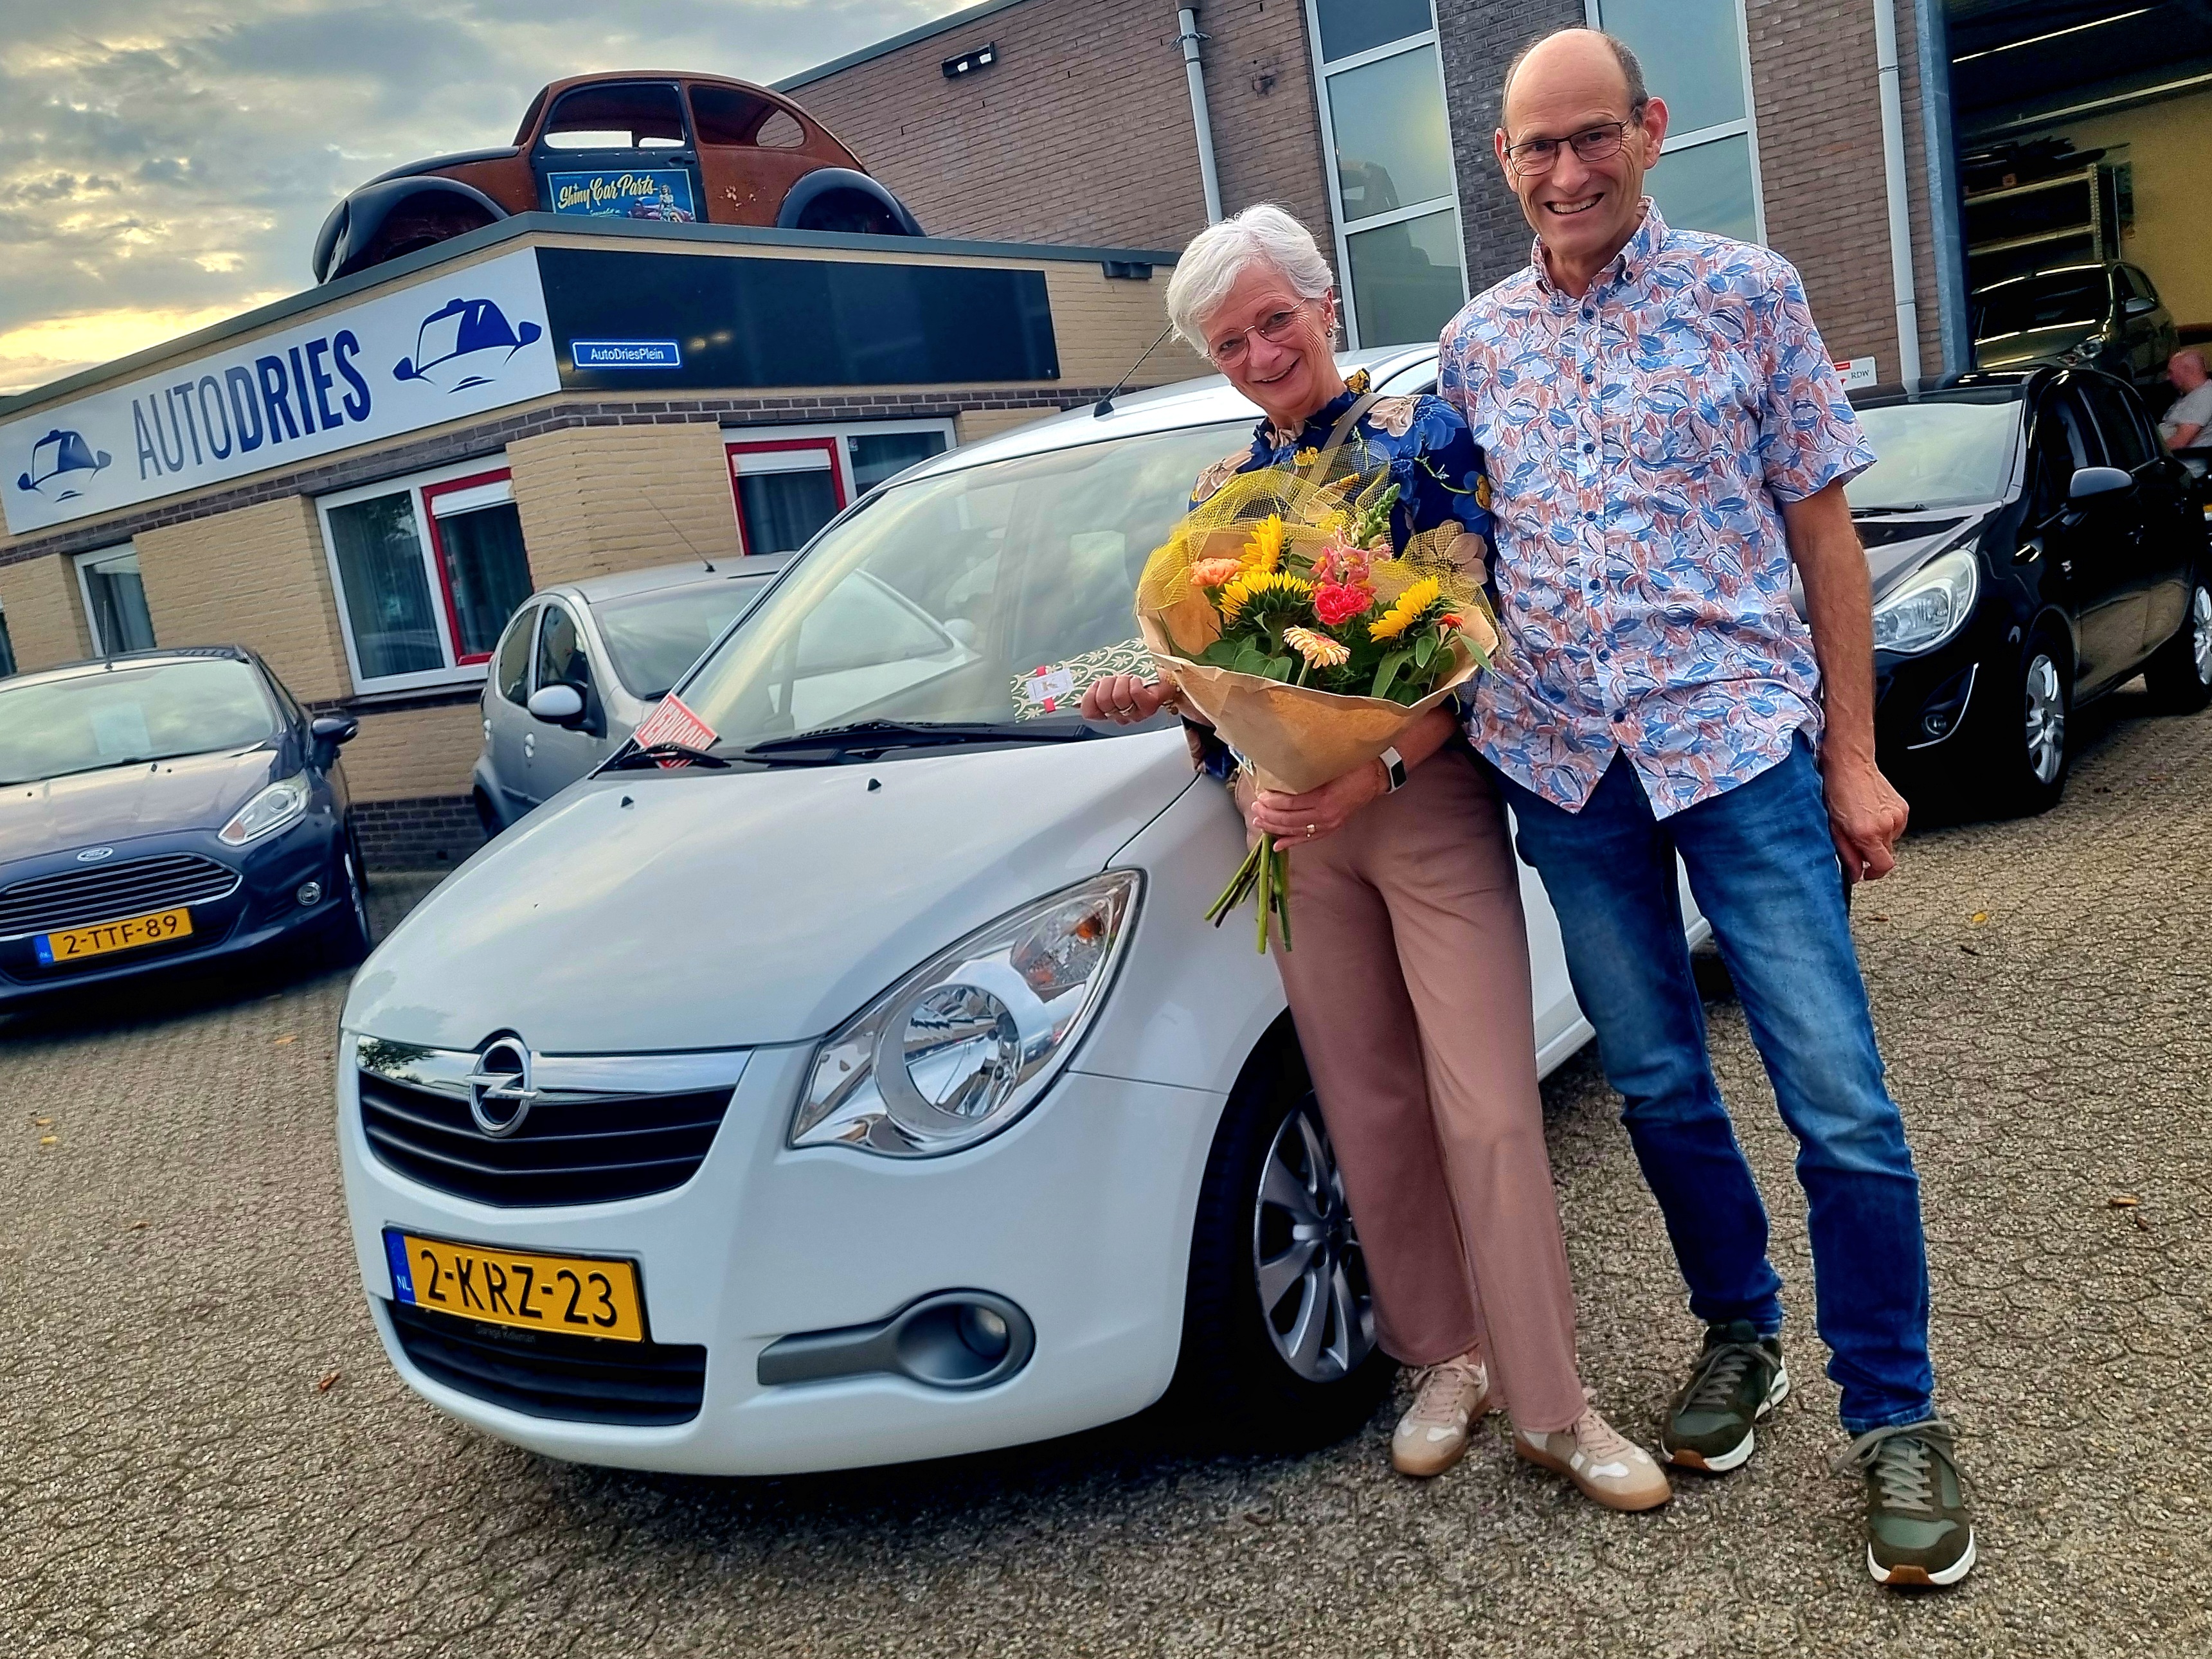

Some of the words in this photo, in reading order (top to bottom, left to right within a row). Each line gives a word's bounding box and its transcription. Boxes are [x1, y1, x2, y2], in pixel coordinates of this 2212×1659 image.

[557, 183, 591, 210] Shiny
[590, 177, 618, 206] Car
[617, 174, 658, 197] Parts
[590, 347, 664, 361] AutoDriesPlein
[1851, 369, 1870, 379] RDW
[132, 329, 372, 481] AUTODRIES
[63, 915, 177, 955] 2-TTF-89
[397, 1274, 411, 1291] NL
[420, 1247, 618, 1327] 2-KRZ-23
